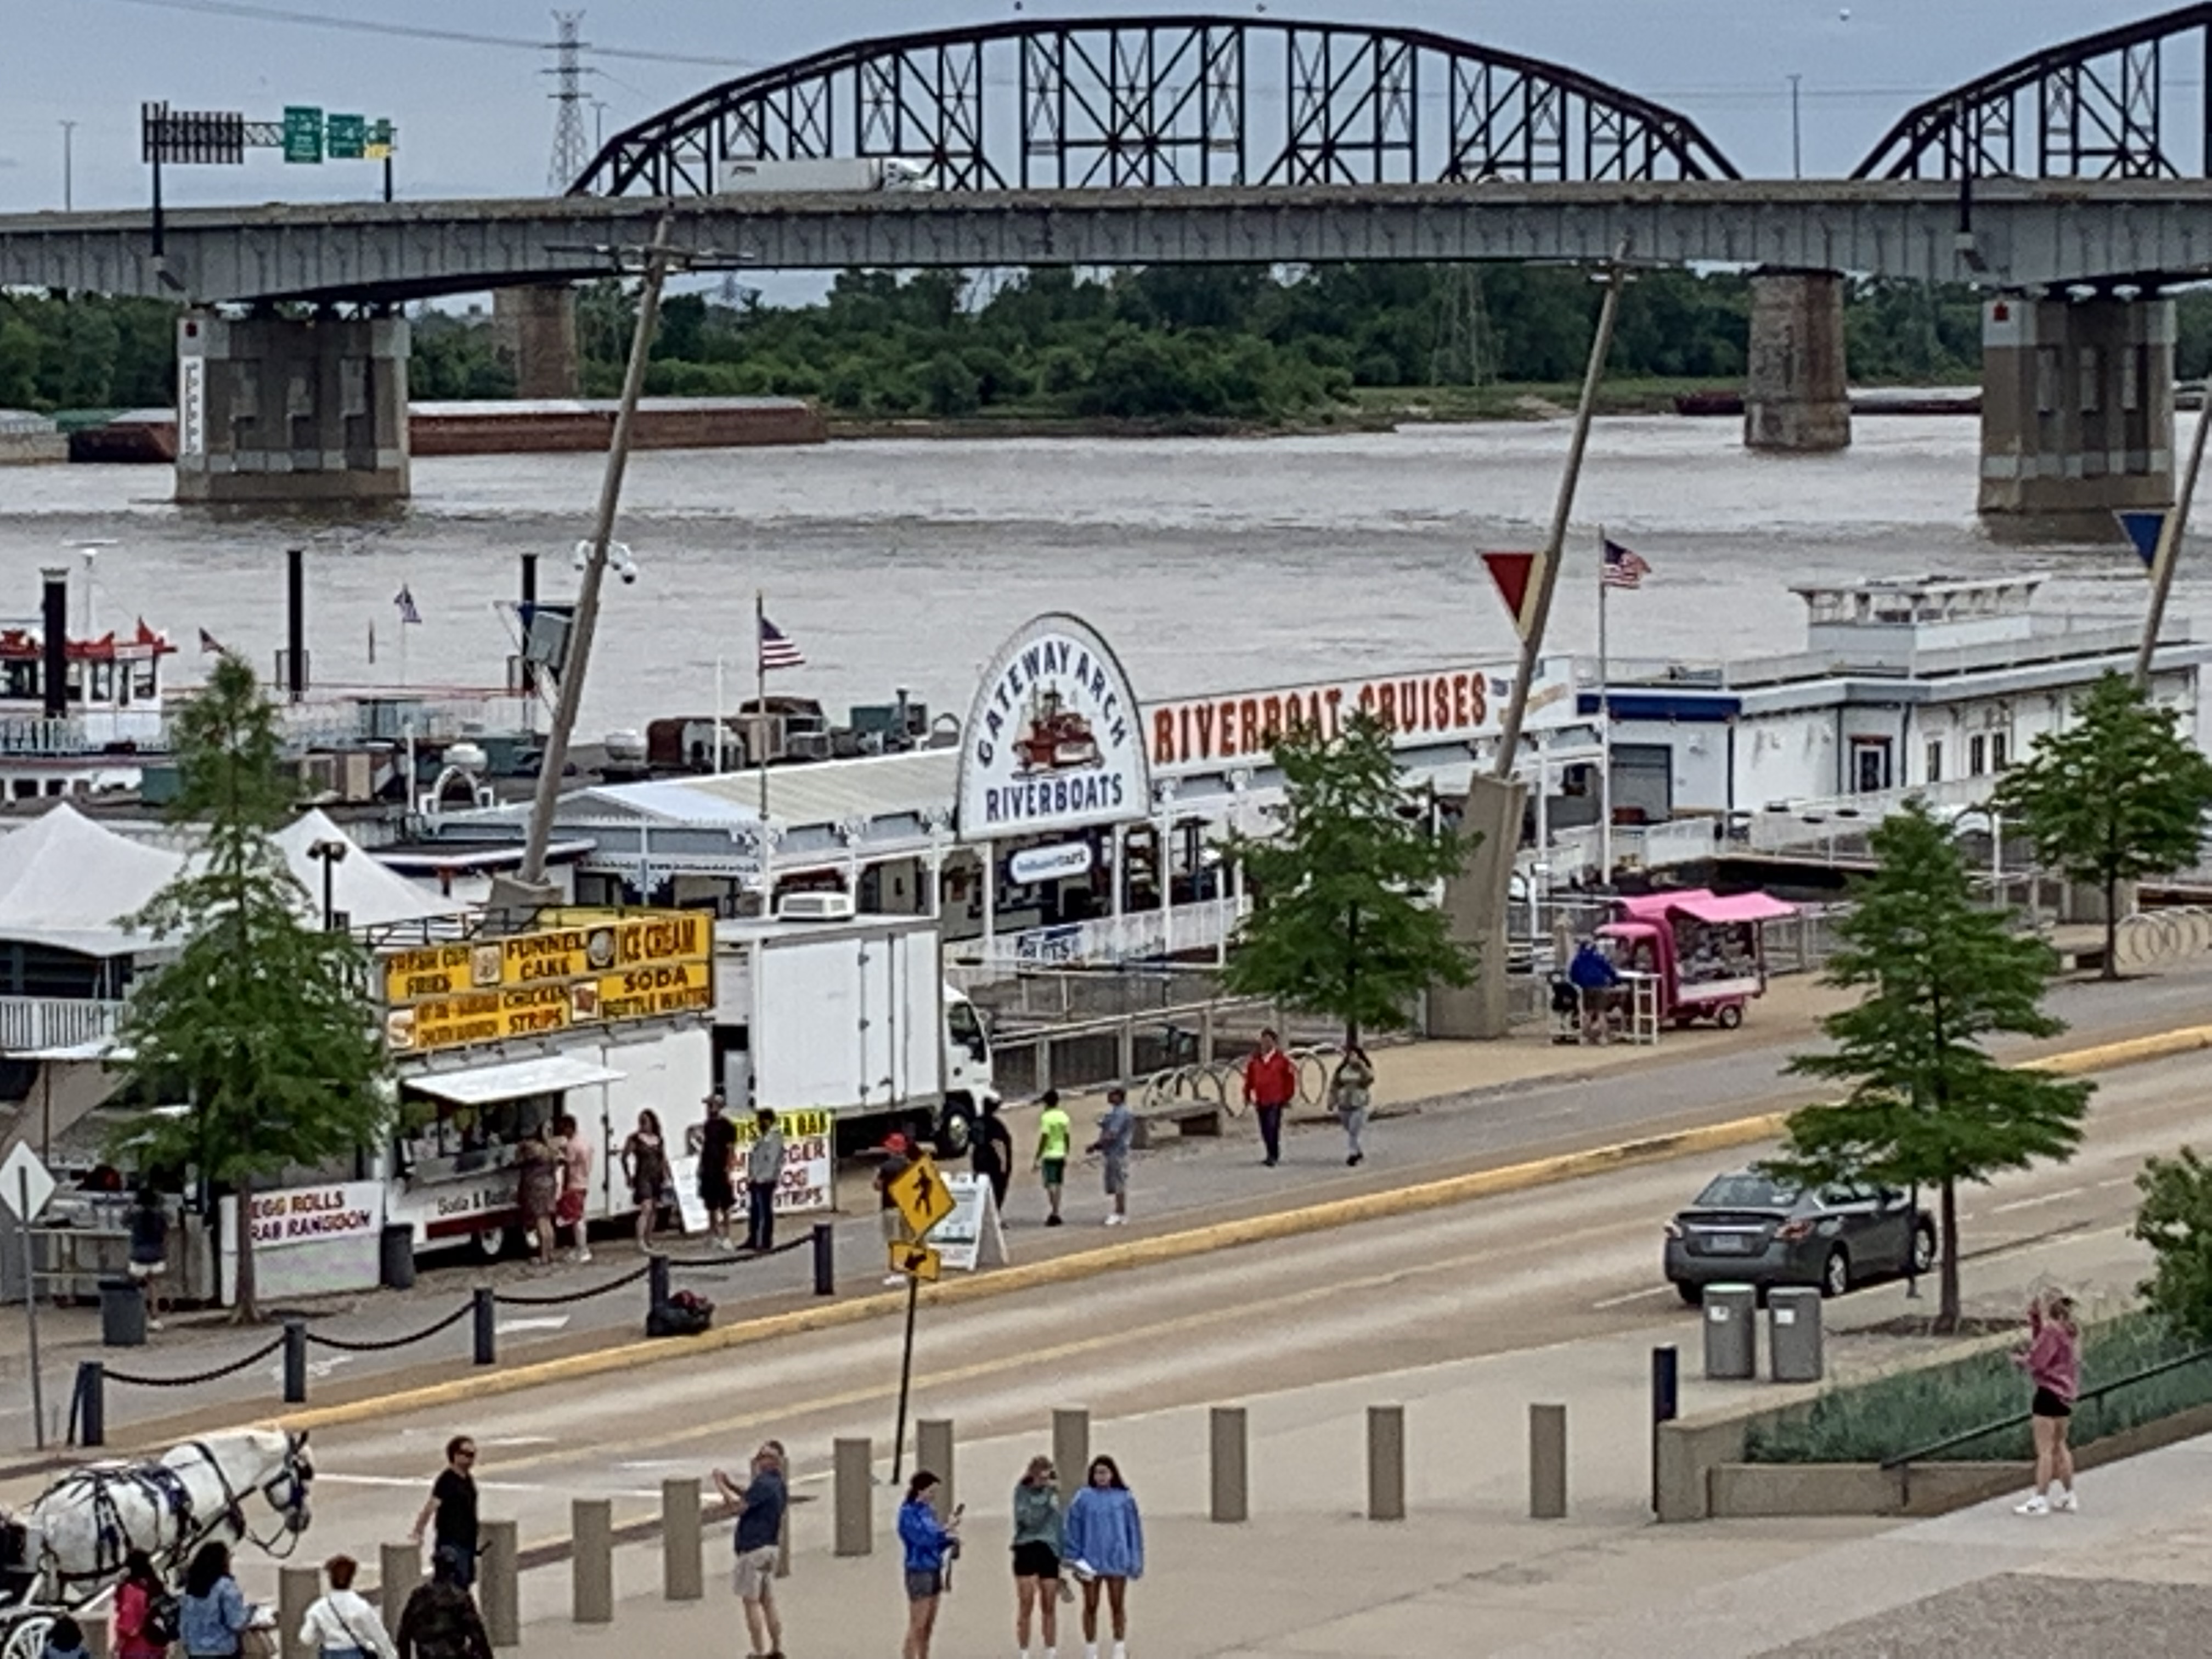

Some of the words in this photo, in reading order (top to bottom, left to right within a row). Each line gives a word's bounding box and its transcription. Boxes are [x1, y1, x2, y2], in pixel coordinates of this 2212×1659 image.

[978, 641, 1071, 768] GATEWAY
[1075, 652, 1128, 749] ARCH
[1154, 687, 1342, 766] RIVERBOAT
[1358, 672, 1487, 735] CRUISES
[986, 773, 1123, 823] RIVERBOATS
[507, 933, 587, 960] FUNNEL
[644, 919, 696, 958] CREAM
[521, 957, 570, 979] CAKE
[624, 964, 688, 994] SODA
[405, 974, 452, 998] FRIES
[504, 985, 567, 1008] CHICKEN
[509, 1006, 562, 1035] STRIPS
[291, 1190, 345, 1213] ROLLS
